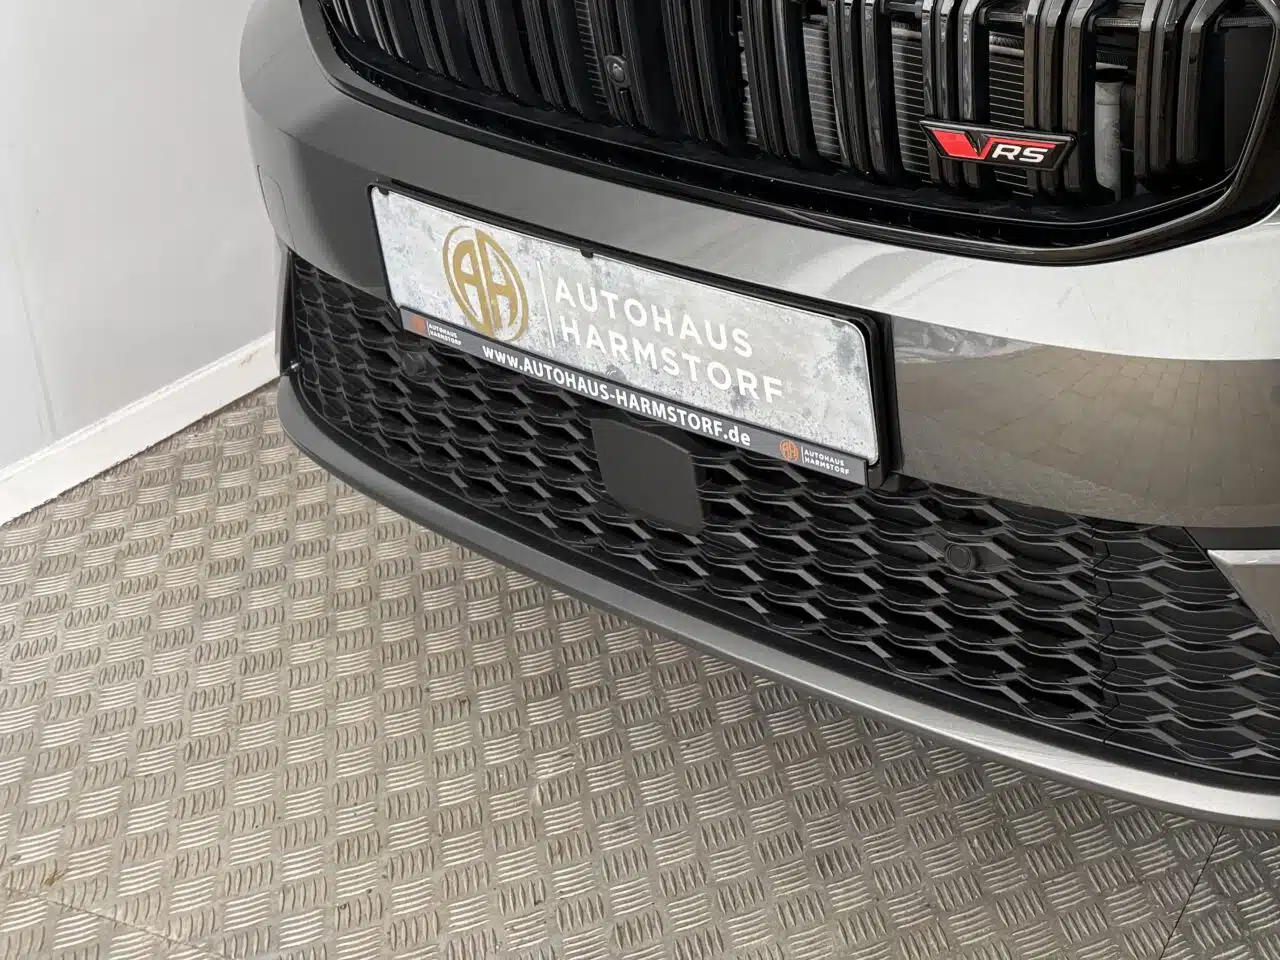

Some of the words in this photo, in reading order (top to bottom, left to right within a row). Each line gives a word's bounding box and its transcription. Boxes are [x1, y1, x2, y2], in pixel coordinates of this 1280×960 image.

[555, 277, 753, 358] AUTOHAUS
[482, 345, 751, 446] www.AUTOHAUS-HARMSTORF.de
[560, 316, 783, 404] HARMSTORF
[804, 449, 845, 466] AUTOHAUS
[804, 458, 850, 475] HARMSTORF
